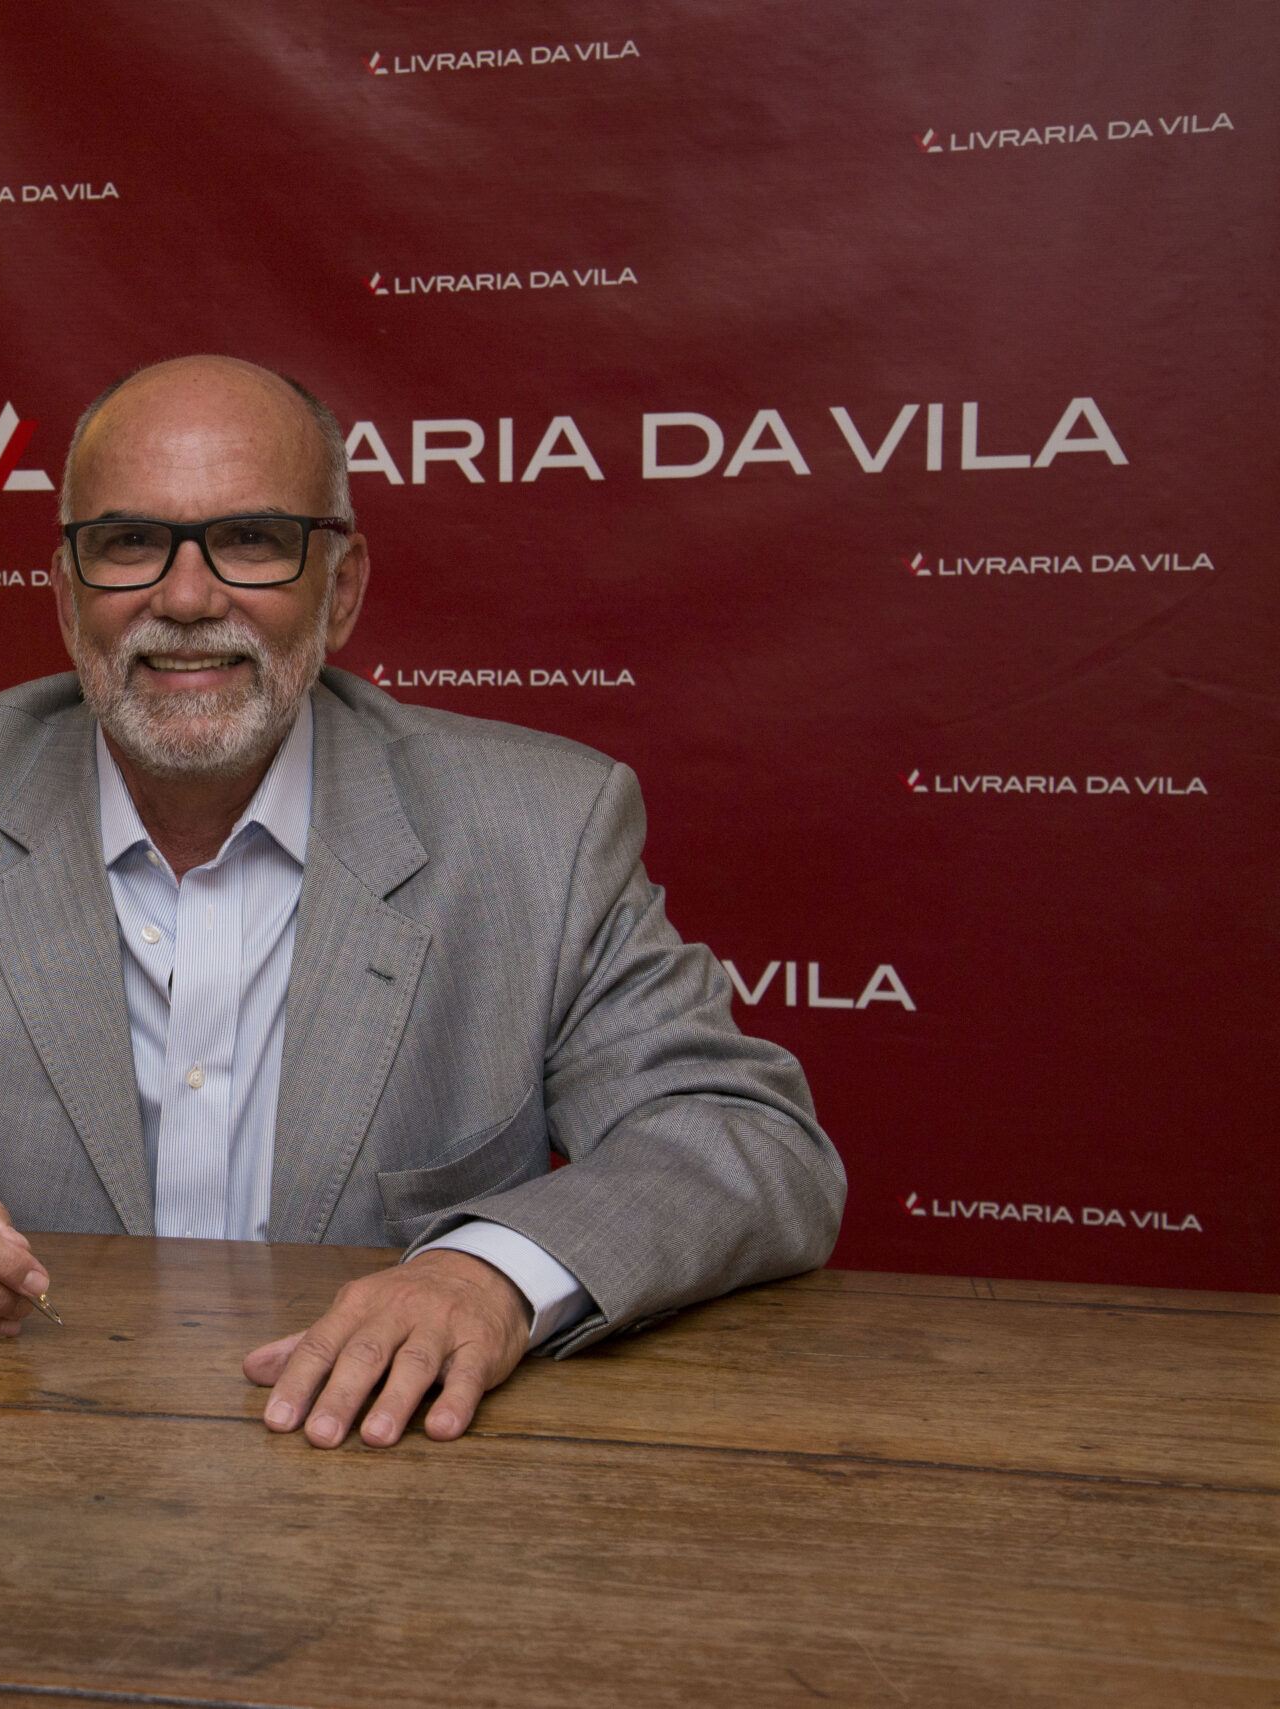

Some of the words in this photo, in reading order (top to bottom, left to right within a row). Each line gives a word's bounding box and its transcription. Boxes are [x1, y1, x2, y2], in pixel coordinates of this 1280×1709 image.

[394, 49, 524, 74] LIVRARIA
[531, 45, 571, 65] DA
[574, 40, 640, 61] VILA
[950, 123, 1098, 152] LIVRARIA
[1107, 119, 1153, 140] DA
[1158, 112, 1234, 135] VILA
[21, 184, 58, 203] DA
[61, 182, 119, 201] VILA
[394, 272, 522, 294] LIVRARIA
[529, 270, 569, 289] DA
[572, 267, 638, 287] VILA
[344, 415, 605, 485] ARIA
[642, 409, 811, 479] DA
[829, 397, 1129, 473] VILA
[938, 556, 1083, 576] LIVRARIA
[1091, 554, 1136, 573] DA
[1140, 552, 1215, 572] VILA
[31, 570, 53, 587] D
[397, 669, 523, 687] LIVRARIA
[529, 669, 569, 686] DA
[571, 669, 636, 686] VILA
[935, 775, 1078, 794] LIVRARIA
[1086, 776, 1130, 794] DA
[1135, 776, 1208, 795] VILA
[722, 959, 917, 1012] VILA
[932, 1199, 1074, 1224] LIVRARIA
[1082, 1207, 1126, 1227] DA
[1130, 1210, 1203, 1232] VILA
